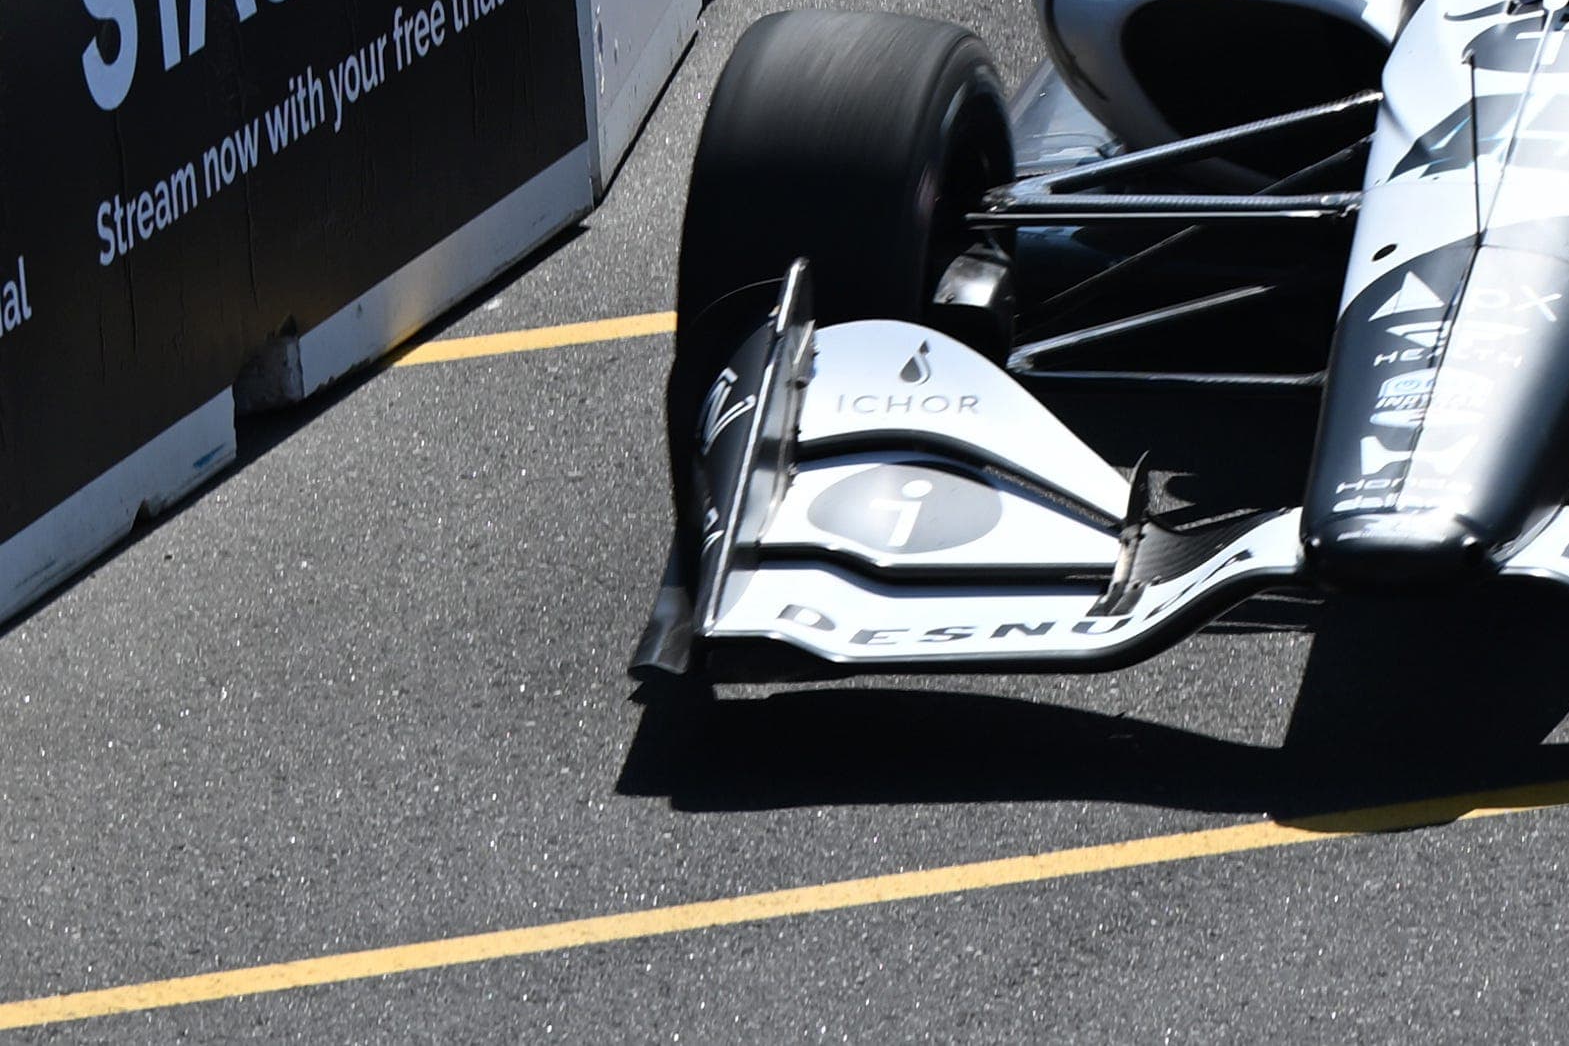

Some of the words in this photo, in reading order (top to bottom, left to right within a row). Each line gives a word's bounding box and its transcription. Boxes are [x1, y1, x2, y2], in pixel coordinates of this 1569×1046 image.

[97, 154, 200, 267] Stream
[202, 118, 259, 195] now
[266, 71, 326, 150] with
[330, 34, 387, 131] your
[836, 392, 981, 415] ICHOR
